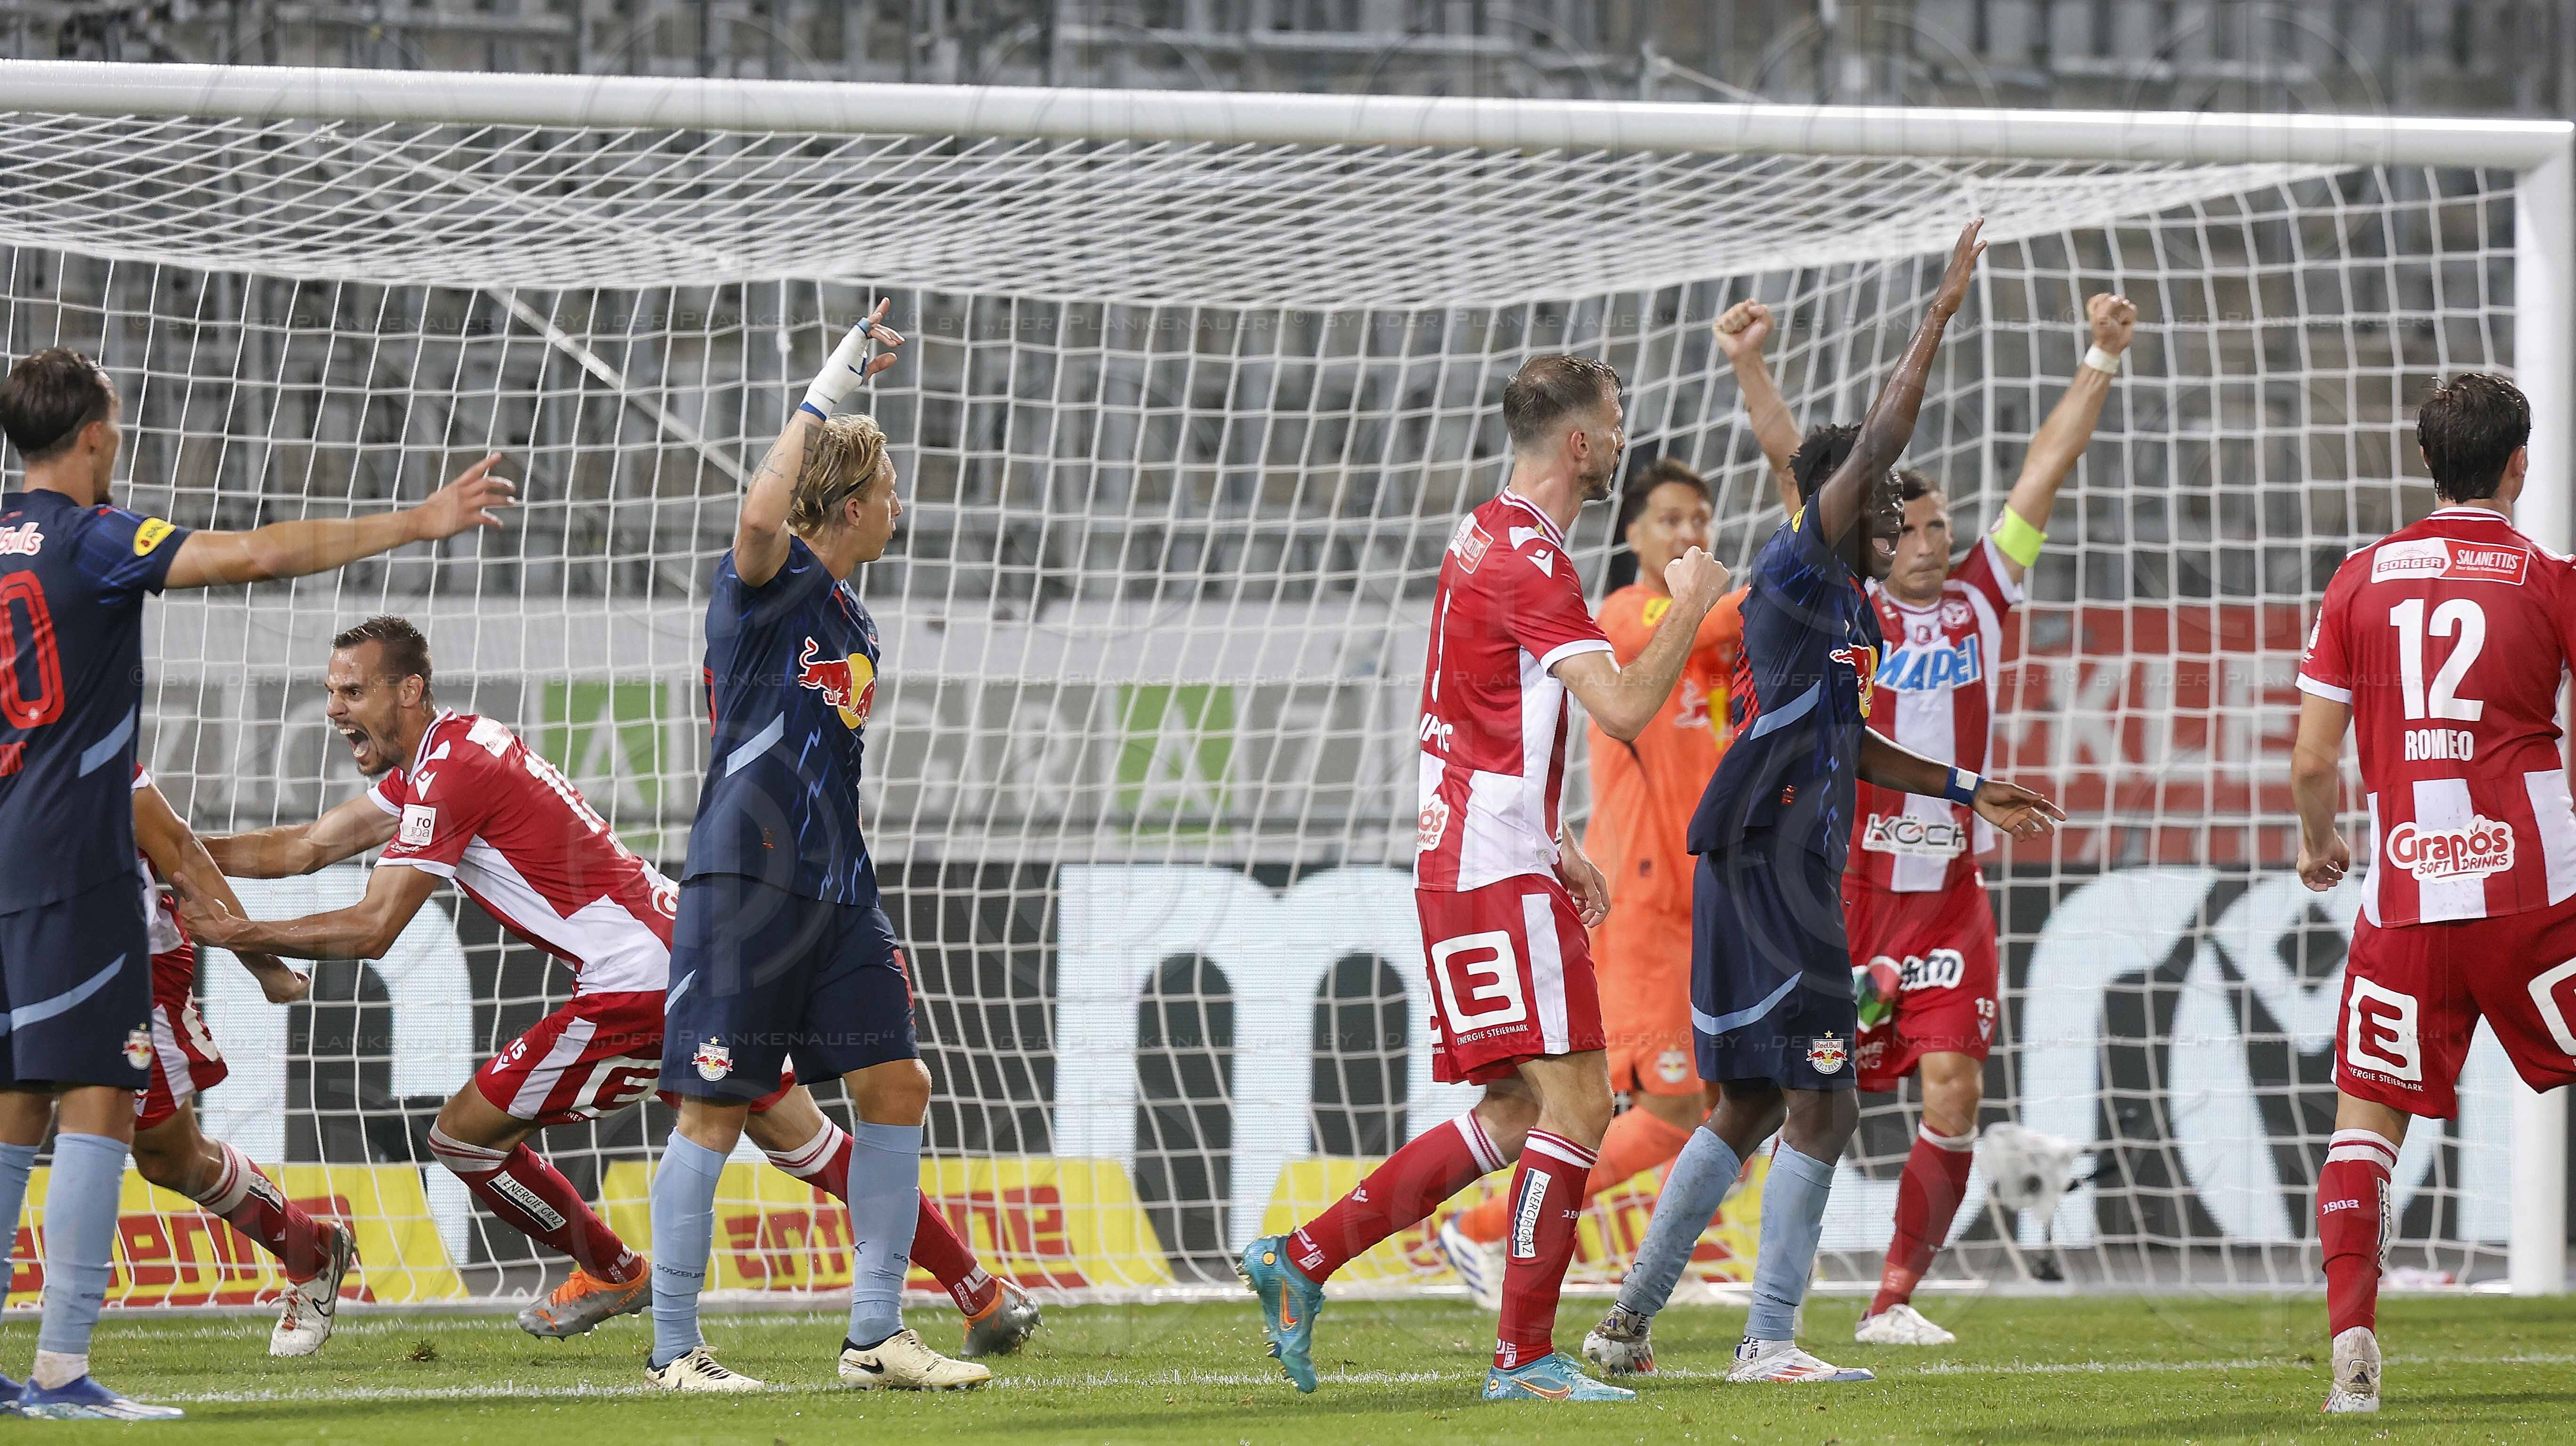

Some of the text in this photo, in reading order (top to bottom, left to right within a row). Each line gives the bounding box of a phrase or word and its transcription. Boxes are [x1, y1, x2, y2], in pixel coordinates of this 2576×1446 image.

[2379, 549, 2519, 572] SORGER SALANETTIS
[1875, 634, 1980, 692] MAPEI
[2390, 598, 2487, 722] 12
[2405, 729, 2474, 761] ROMEO
[2418, 854, 2508, 875] SOFT DRINKS
[1974, 997, 1996, 1018] 13
[1457, 1023, 1530, 1046] ENERGIE STEIERMARK
[509, 1037, 528, 1060] 15
[2379, 1074, 2423, 1092] STEIERMARK
[503, 1179, 565, 1227] ENERGIE GRAZ
[1521, 1181, 1545, 1254] ENERGIE GRAZ
